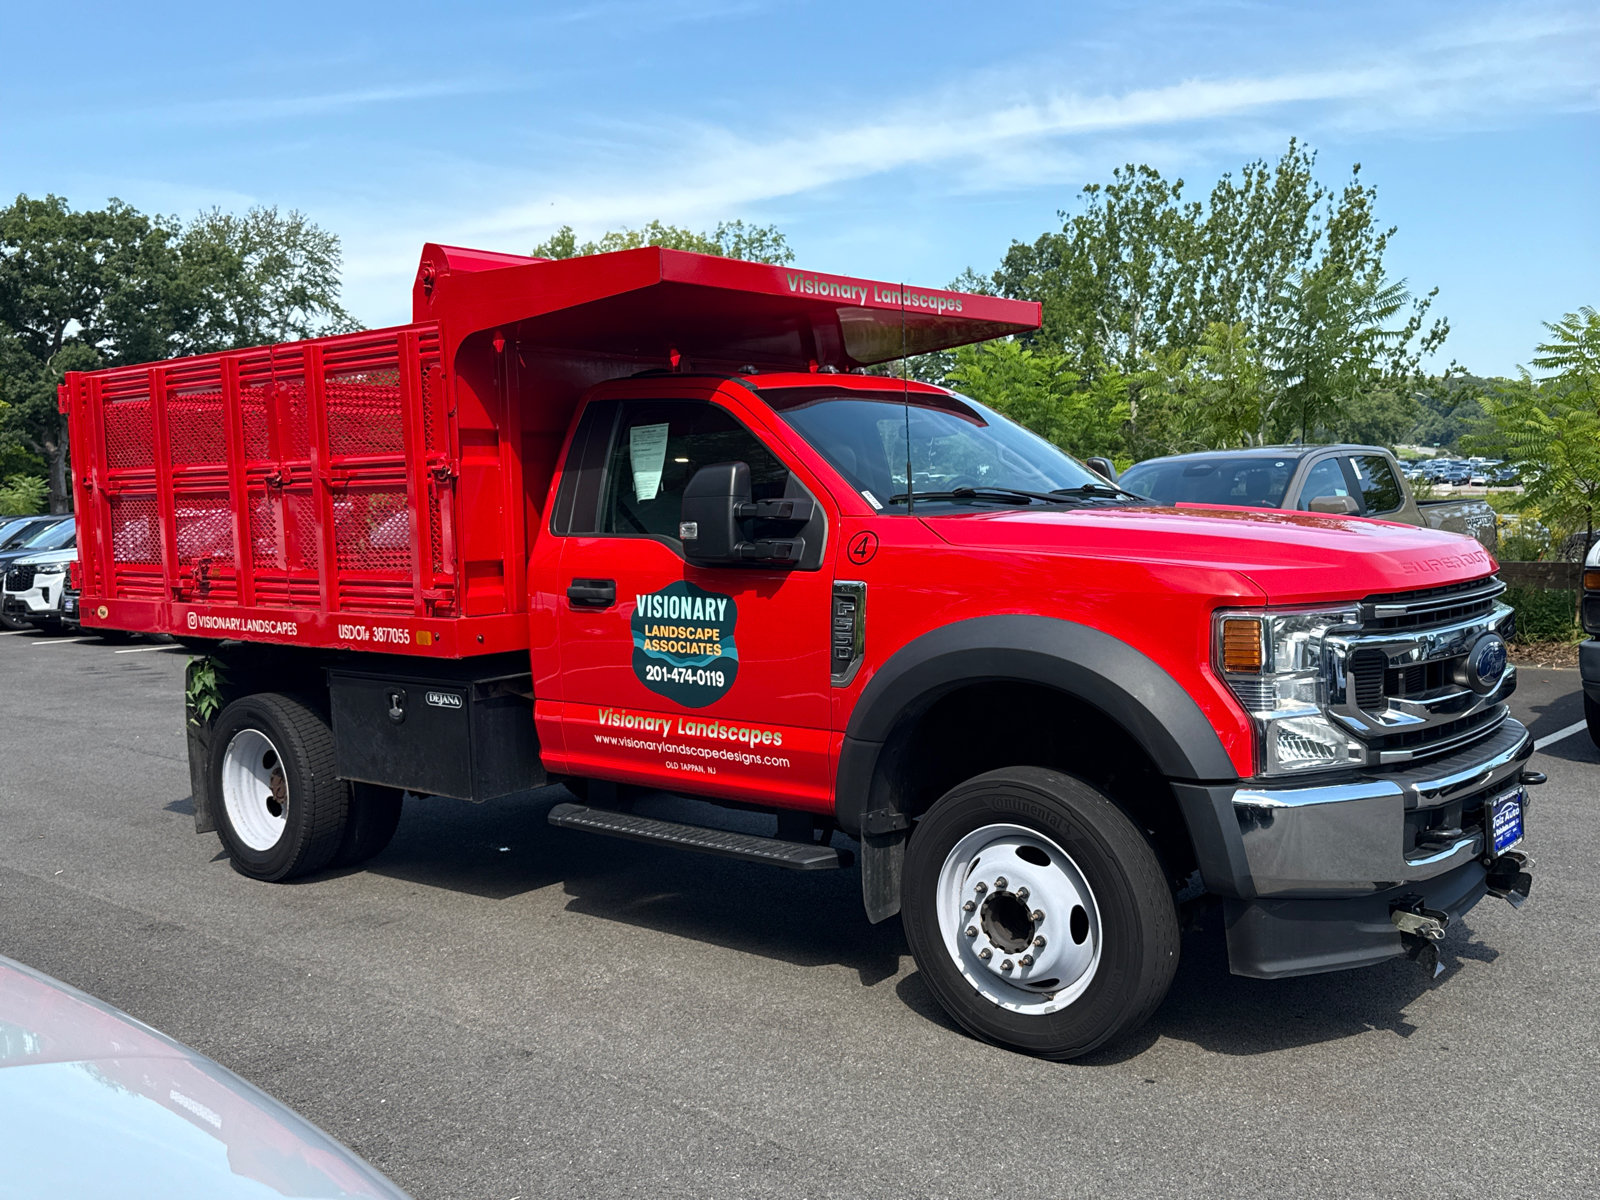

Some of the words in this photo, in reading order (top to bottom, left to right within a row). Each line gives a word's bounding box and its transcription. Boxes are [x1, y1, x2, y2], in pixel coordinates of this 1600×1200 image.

[786, 273, 869, 307] Visionary
[874, 285, 963, 315] Landscapes
[853, 536, 869, 558] 4
[636, 594, 728, 622] VISIONARY
[338, 624, 370, 641] USDOT#
[373, 626, 410, 645] 3877055
[644, 624, 720, 641] LANDSCAPE
[643, 639, 722, 656] ASSOCIATES
[646, 664, 725, 687] 201-474-0119
[429, 693, 460, 706] DEJANA
[598, 709, 672, 738] Visionary
[678, 718, 783, 748] Landscapes
[594, 734, 791, 768] www.visionarylandscapedesigns.com
[665, 760, 679, 770] OLD
[680, 763, 706, 775] TAPPAN,
[707, 766, 717, 775] NJ
